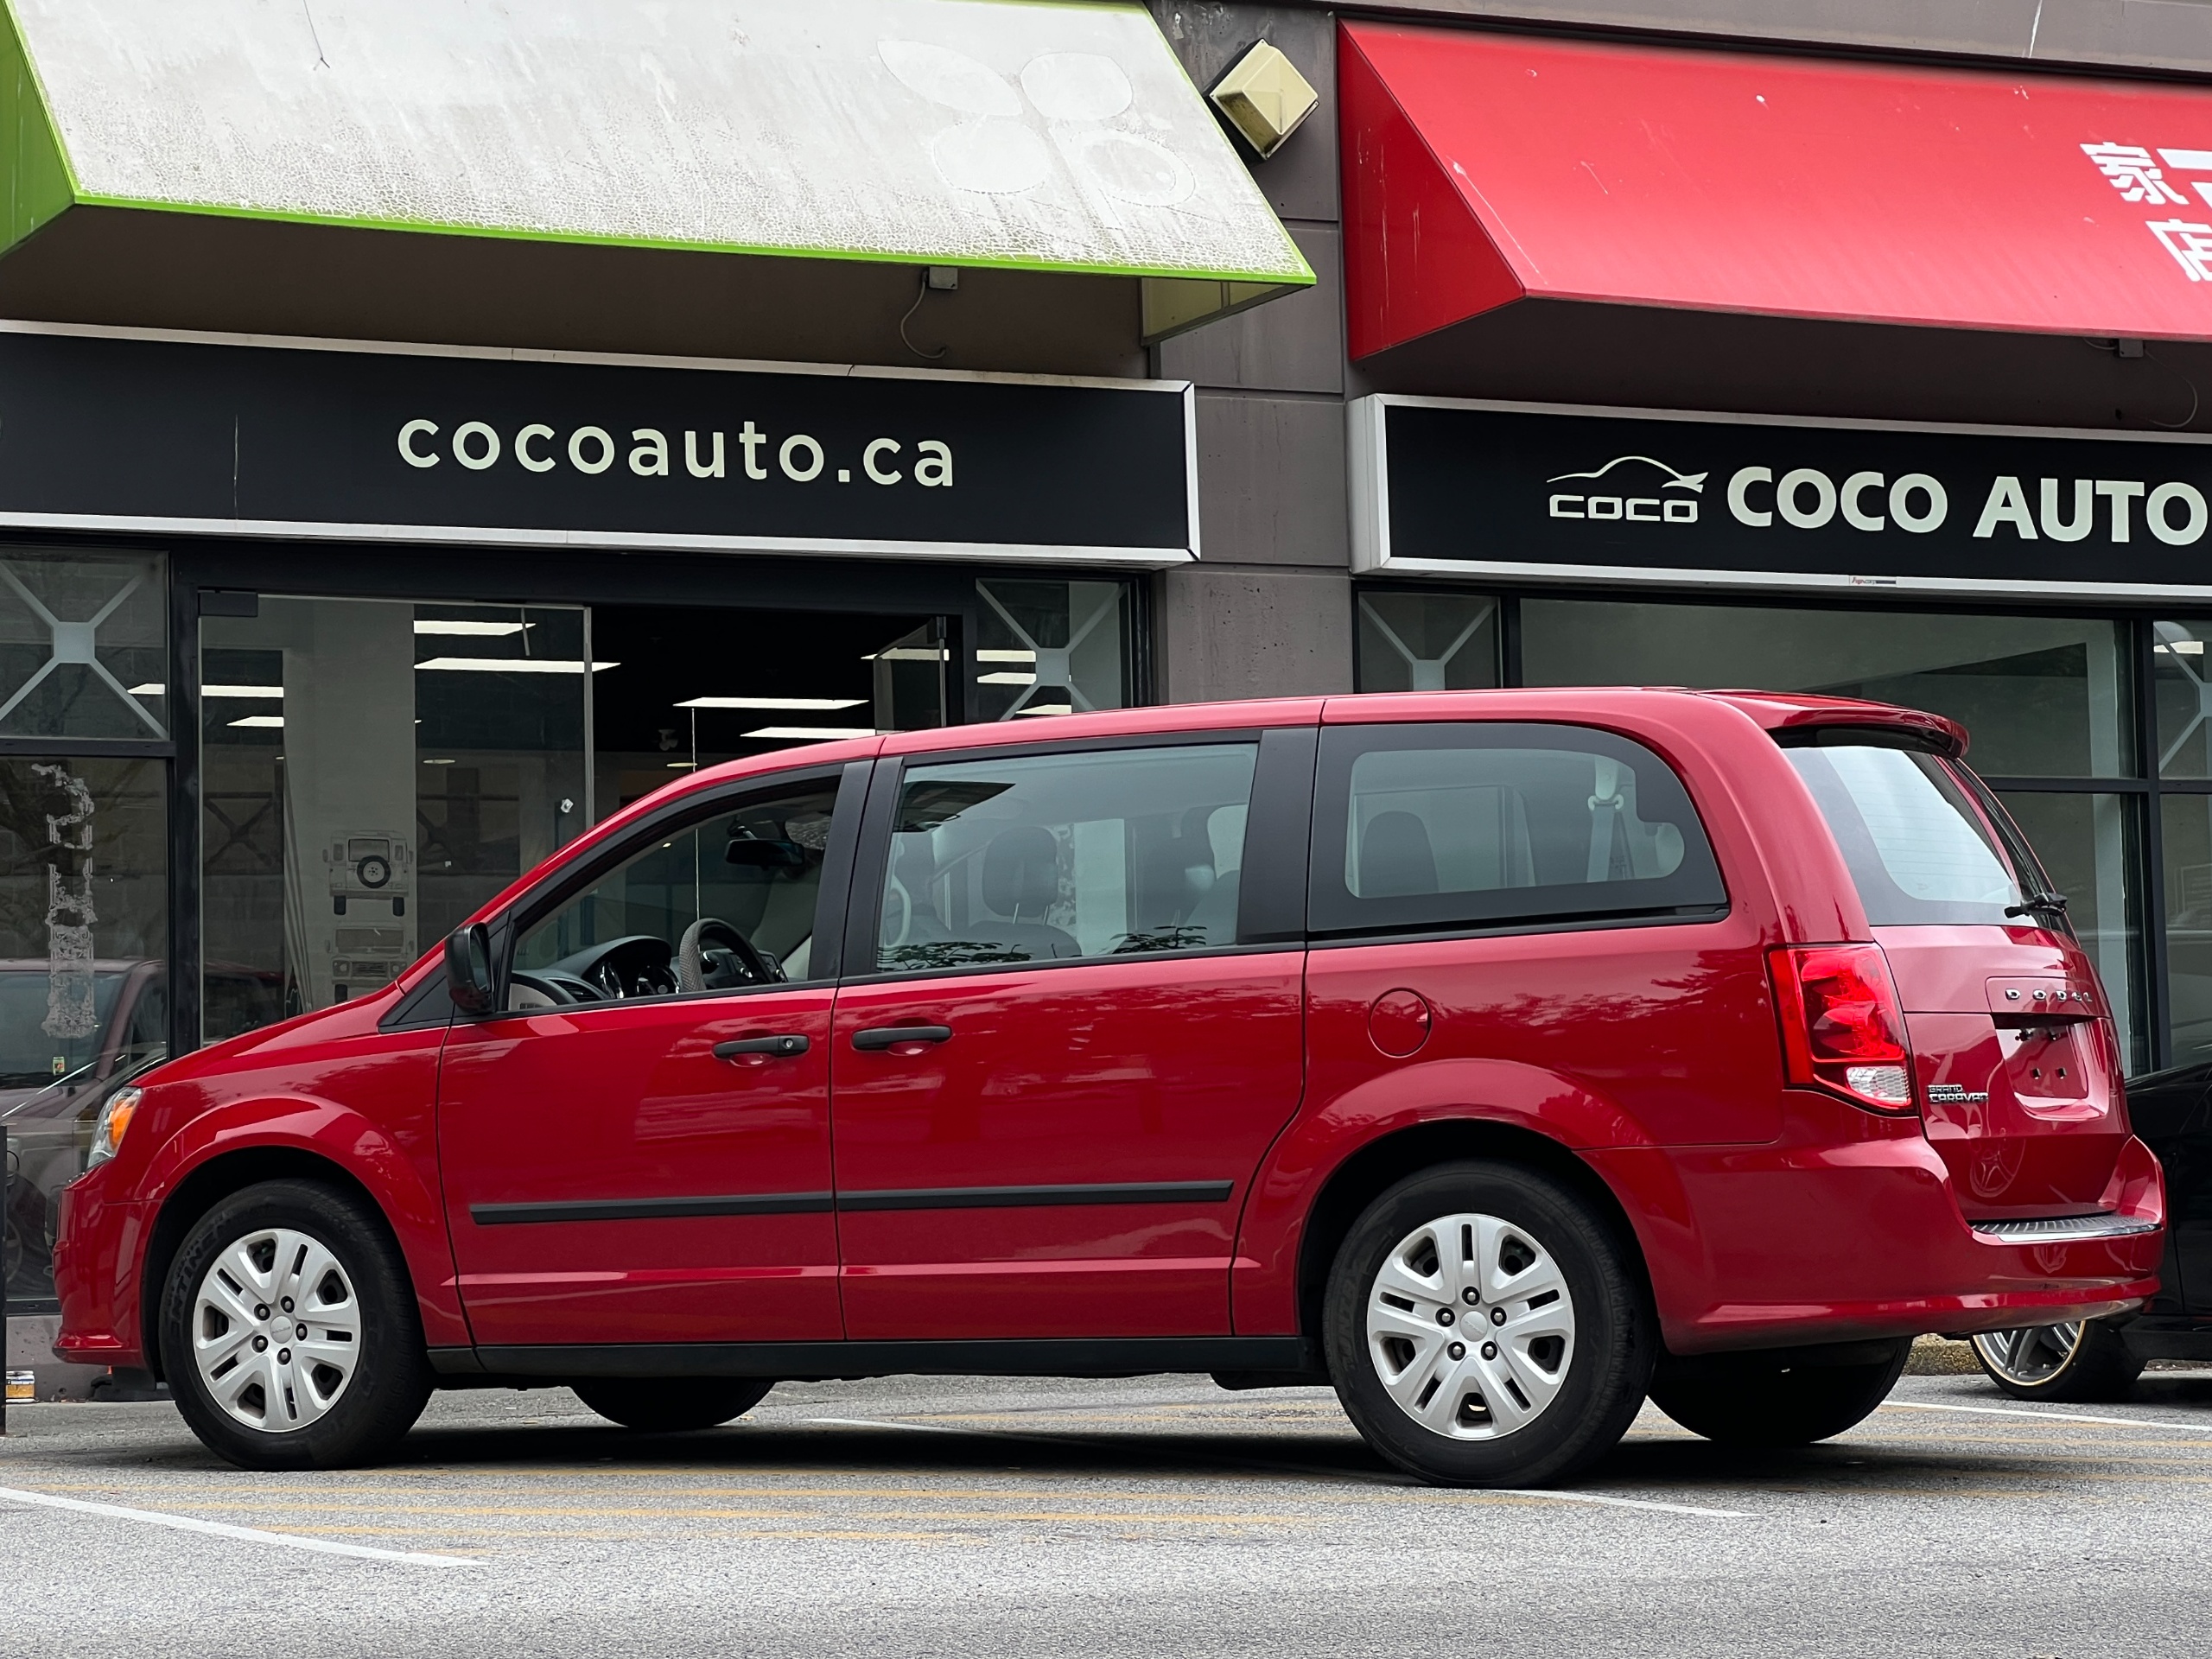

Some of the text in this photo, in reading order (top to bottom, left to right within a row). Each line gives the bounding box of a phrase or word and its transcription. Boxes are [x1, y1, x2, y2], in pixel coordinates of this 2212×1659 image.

[2079, 141, 2190, 205] 家
[397, 419, 954, 488] cocoauto.ca
[1549, 494, 1699, 523] COCO
[1727, 466, 2209, 546] COCO AUTO
[1928, 1084, 1963, 1094] GRAND
